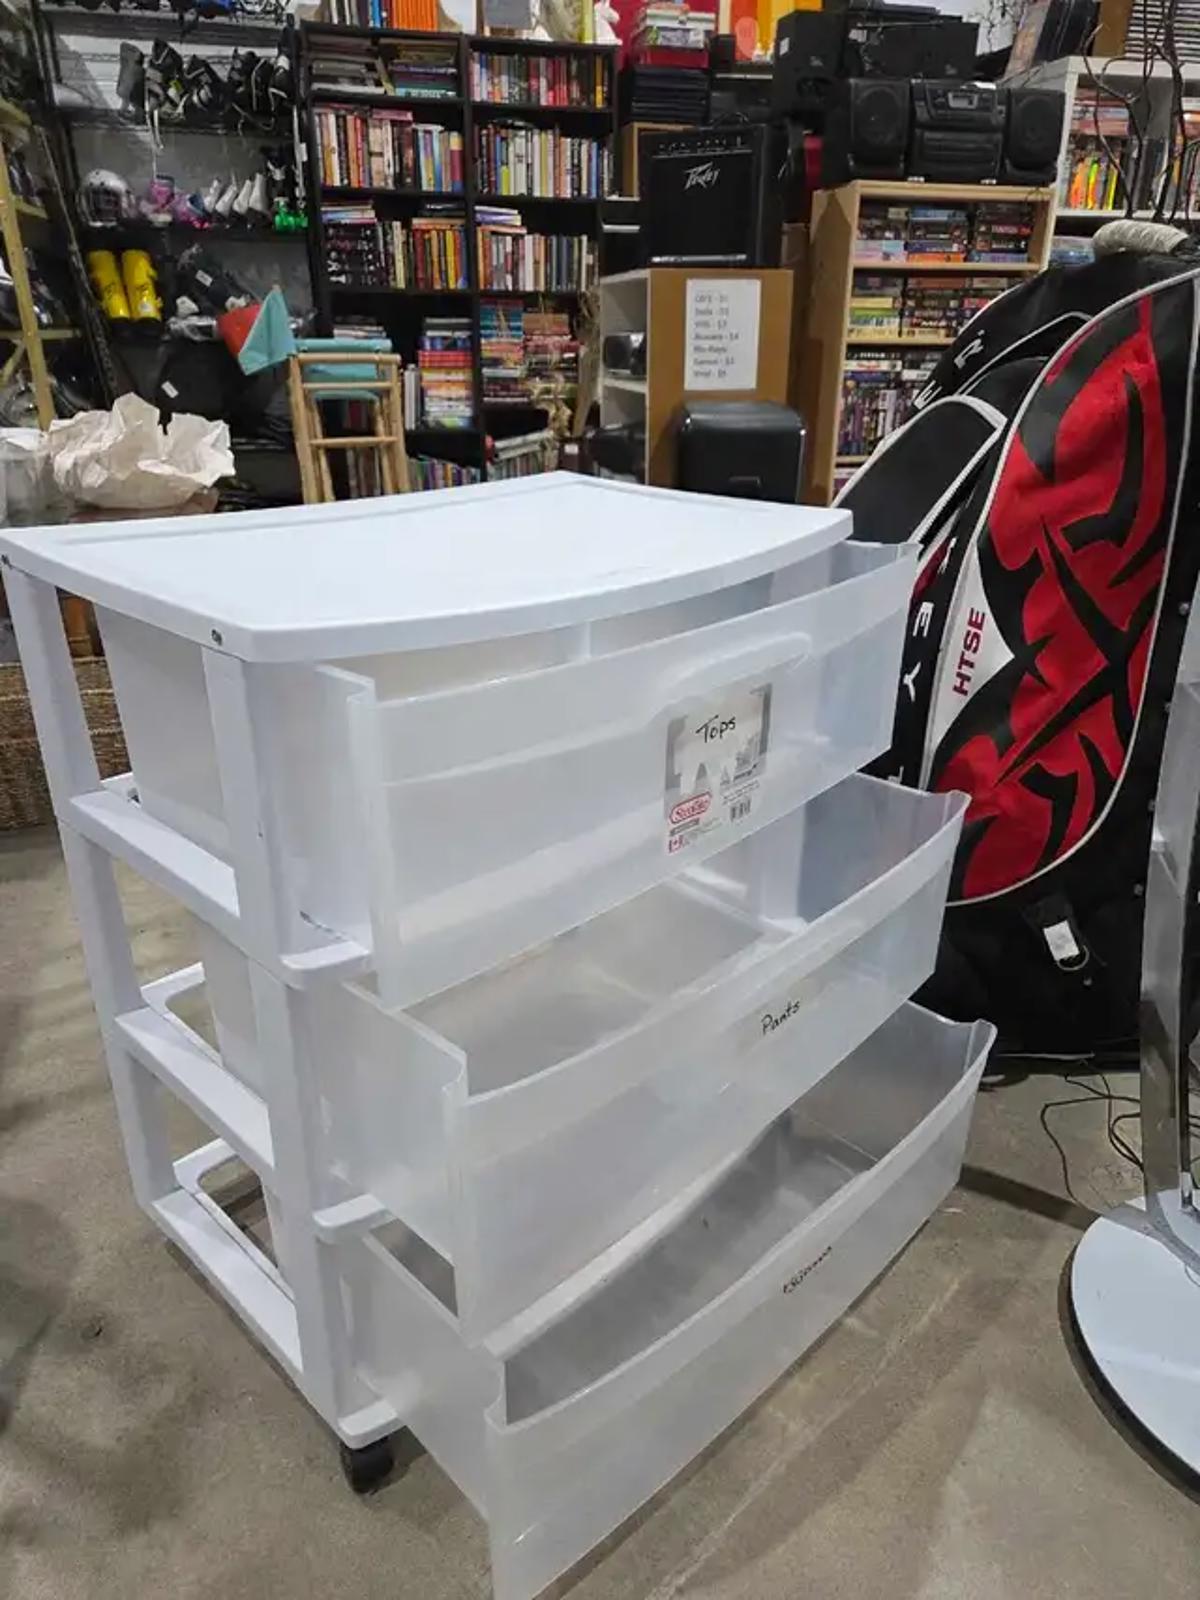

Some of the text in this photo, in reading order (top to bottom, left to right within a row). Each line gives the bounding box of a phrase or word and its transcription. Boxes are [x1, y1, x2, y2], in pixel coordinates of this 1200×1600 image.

[952, 607, 986, 697] HTSE
[695, 714, 736, 744] Tops
[760, 1000, 801, 1035] Pants
